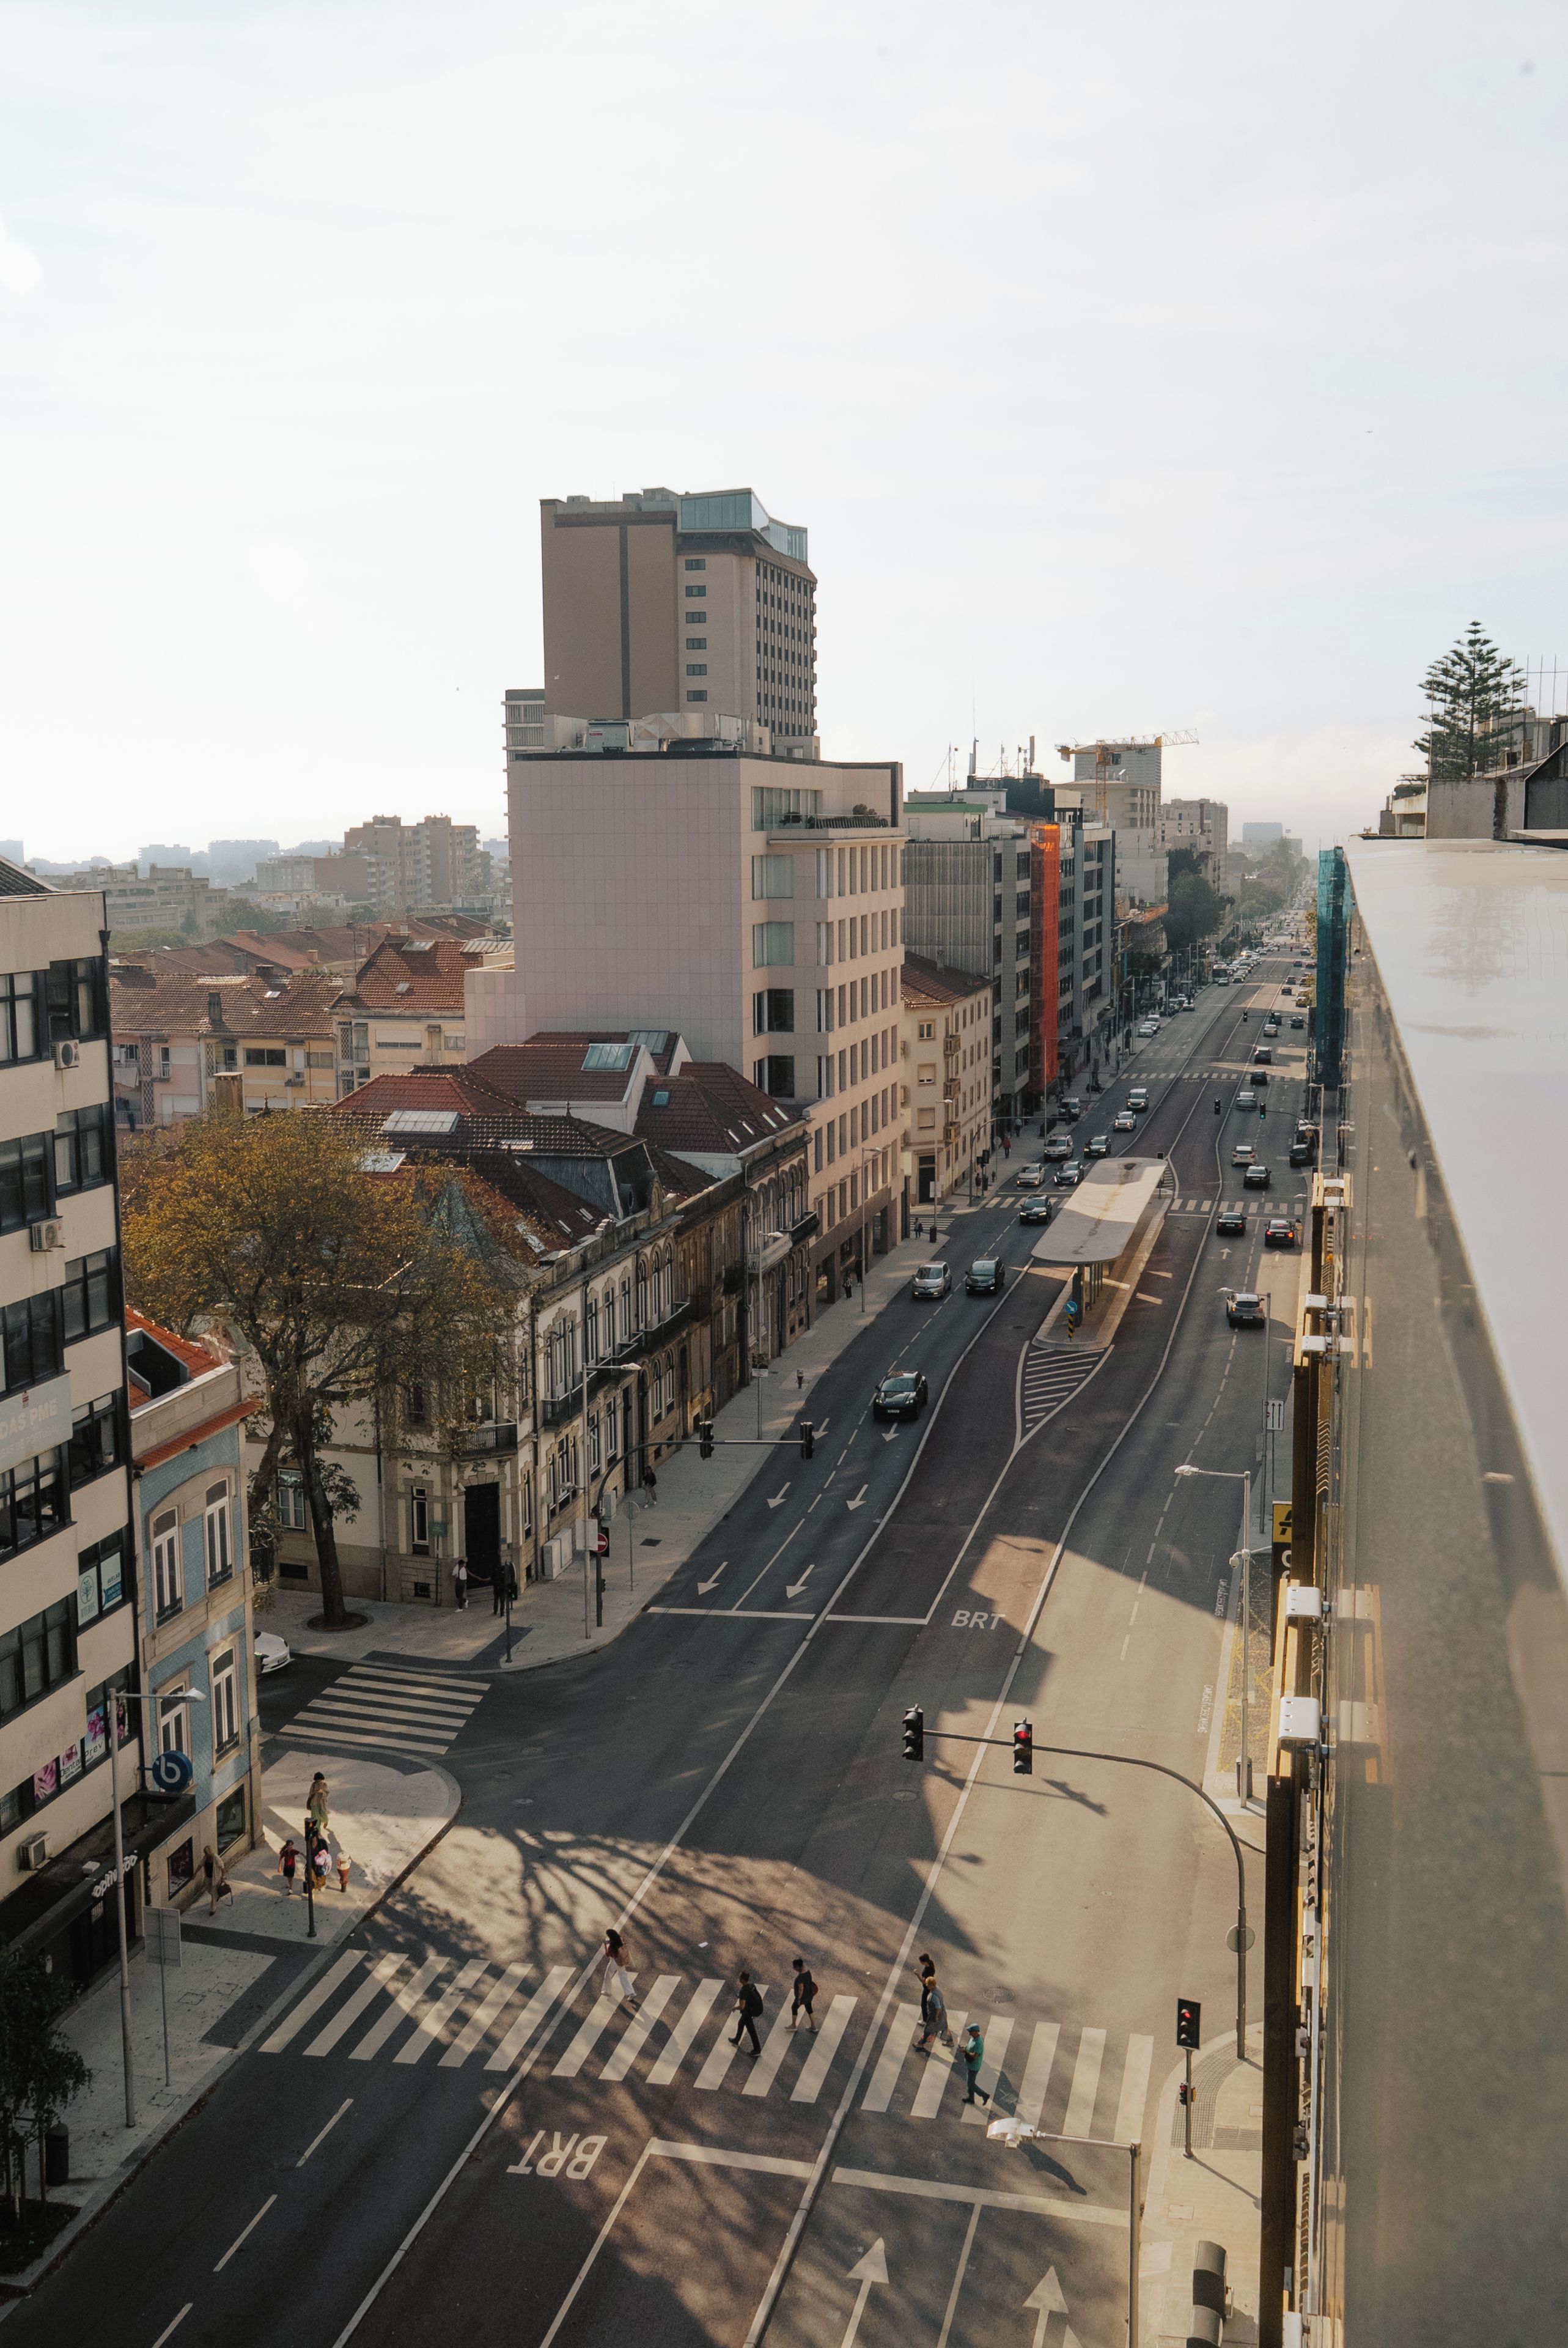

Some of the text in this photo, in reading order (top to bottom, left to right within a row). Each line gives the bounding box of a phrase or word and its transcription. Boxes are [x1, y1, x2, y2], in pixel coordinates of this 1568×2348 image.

[29, 1398, 58, 1426] PME
[951, 1610, 1006, 1631] BRT
[506, 2130, 608, 2180] BRT
